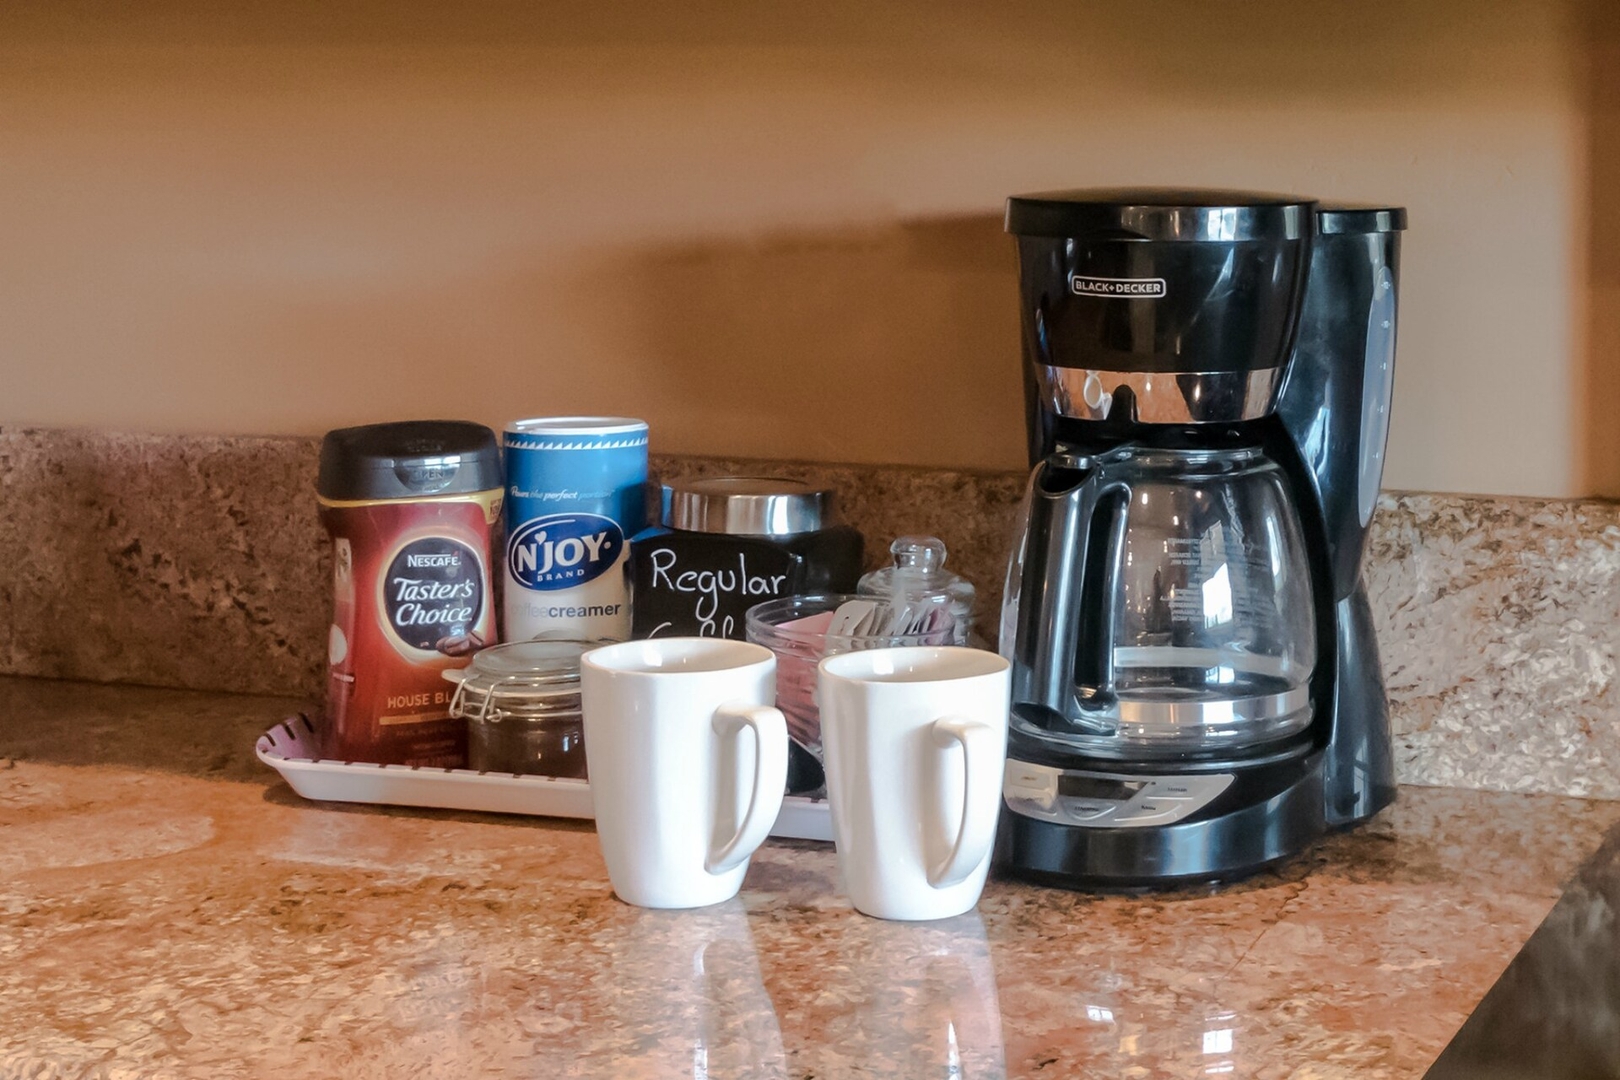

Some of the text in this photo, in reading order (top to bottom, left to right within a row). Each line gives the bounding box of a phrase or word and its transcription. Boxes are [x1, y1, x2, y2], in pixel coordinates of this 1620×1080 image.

[1075, 280, 1162, 293] BLACK+DECKER
[543, 488, 578, 501] perfect
[536, 568, 585, 582] BRAND
[393, 577, 475, 602] Taster's
[650, 548, 787, 622] Regular
[396, 603, 473, 626] Choice
[387, 693, 431, 709] HOUSE
